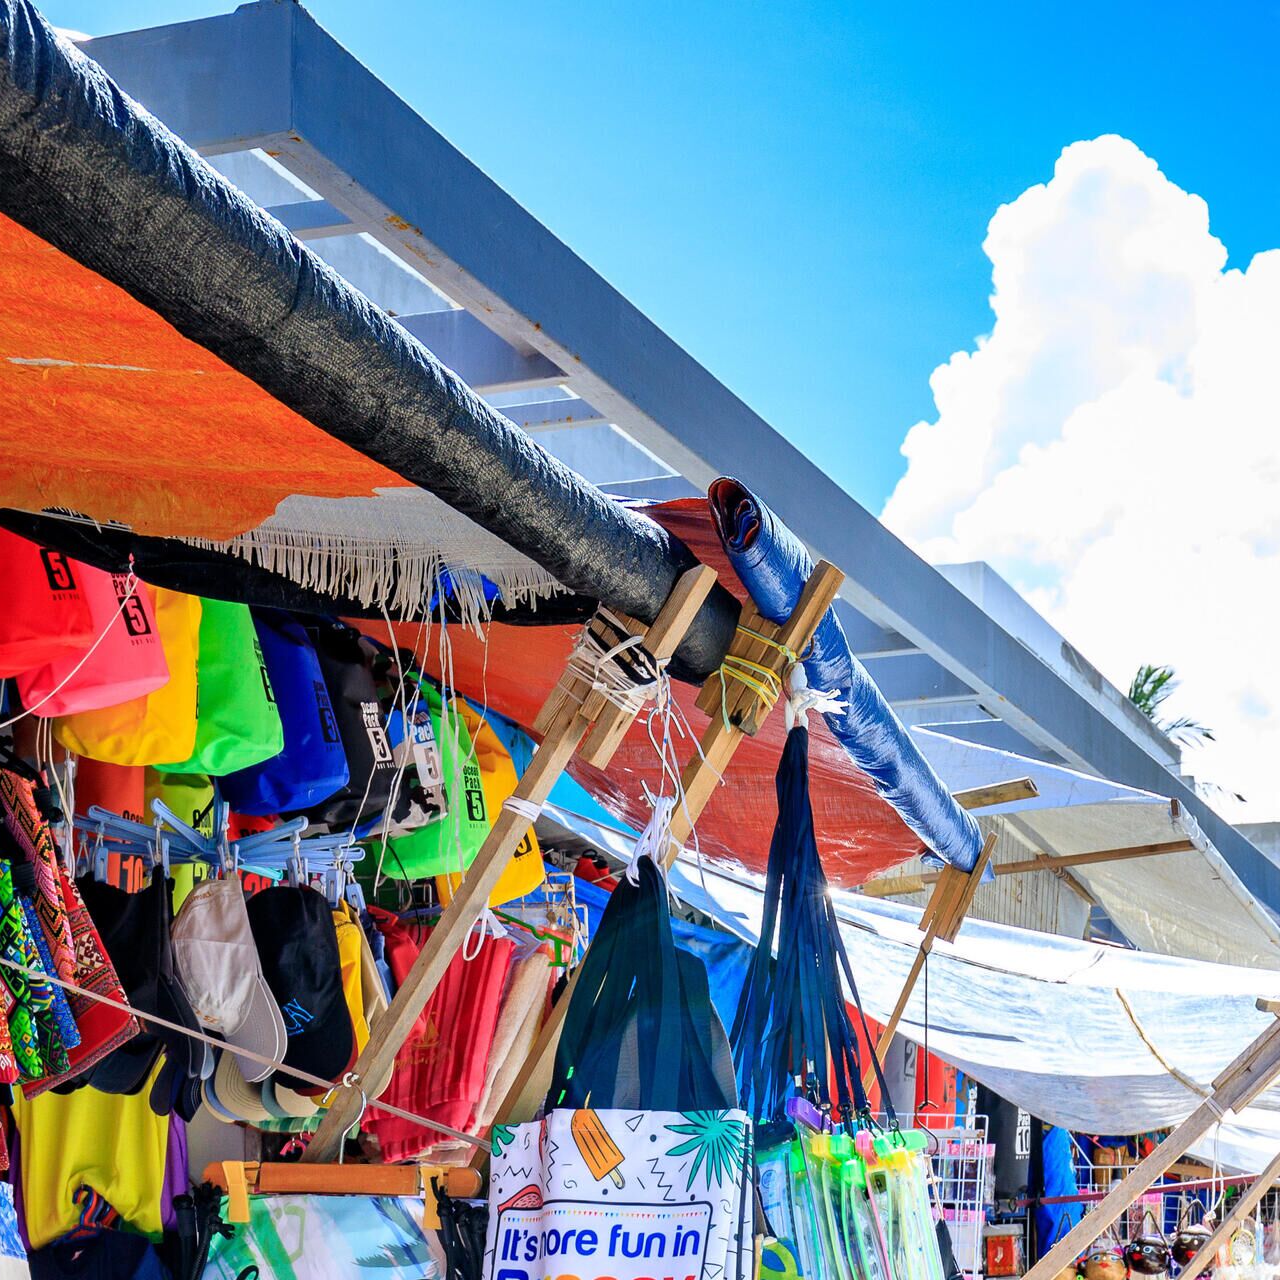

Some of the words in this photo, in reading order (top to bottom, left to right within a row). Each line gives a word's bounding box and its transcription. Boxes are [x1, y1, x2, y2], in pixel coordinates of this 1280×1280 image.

[501, 1228, 538, 1261] It's
[608, 1224, 666, 1258] fun
[672, 1225, 700, 1257] in
